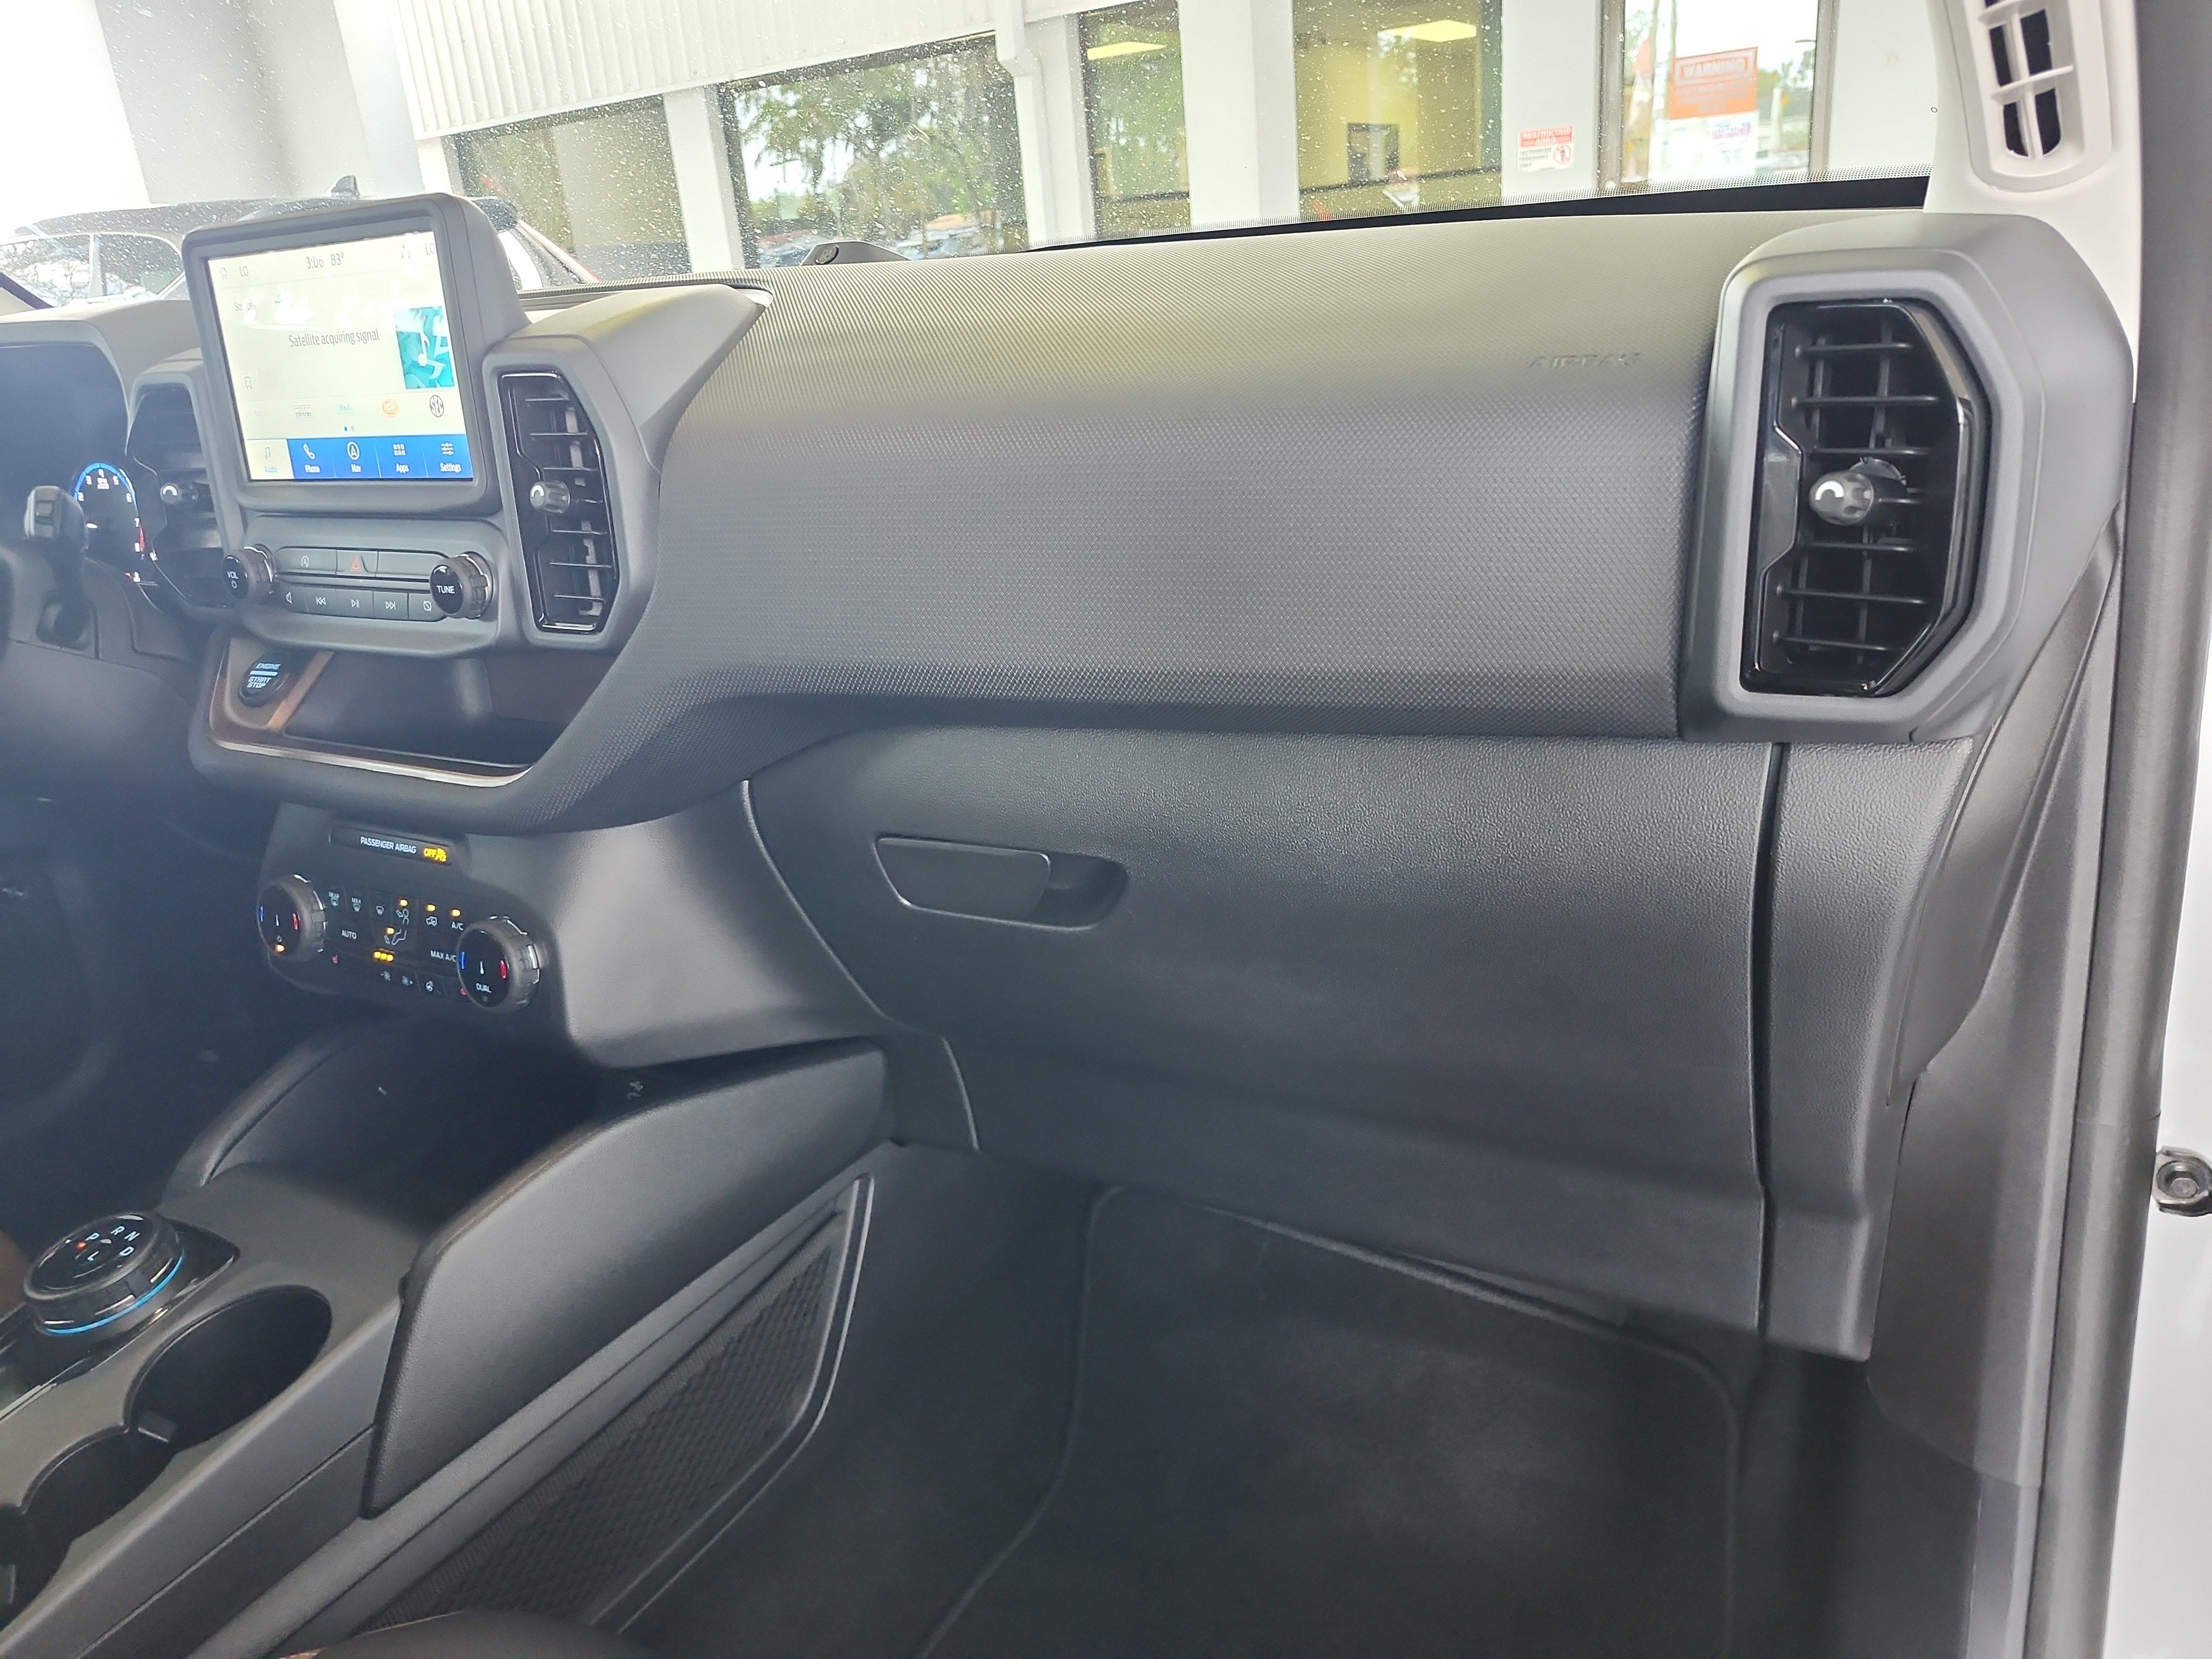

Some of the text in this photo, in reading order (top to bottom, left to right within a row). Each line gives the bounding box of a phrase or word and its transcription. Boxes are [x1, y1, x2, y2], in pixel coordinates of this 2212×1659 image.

[425, 243, 435, 255] LO
[306, 254, 324, 269] 3:06
[240, 266, 249, 276] LO
[288, 327, 380, 347] Satellite acquiring signal
[395, 463, 409, 473] Apps
[440, 462, 461, 473] Settings
[227, 571, 239, 579] VOL
[436, 585, 455, 594] TUNE
[361, 837, 437, 858] PASSENGER AIRBAG OFF
[452, 921, 464, 931] A/C
[342, 930, 357, 940] AUTO
[430, 950, 456, 962] MAX A/C
[85, 1232, 100, 1241] P
[110, 1226, 140, 1242] R N
[87, 1251, 99, 1261] L
[119, 1246, 134, 1256] D
